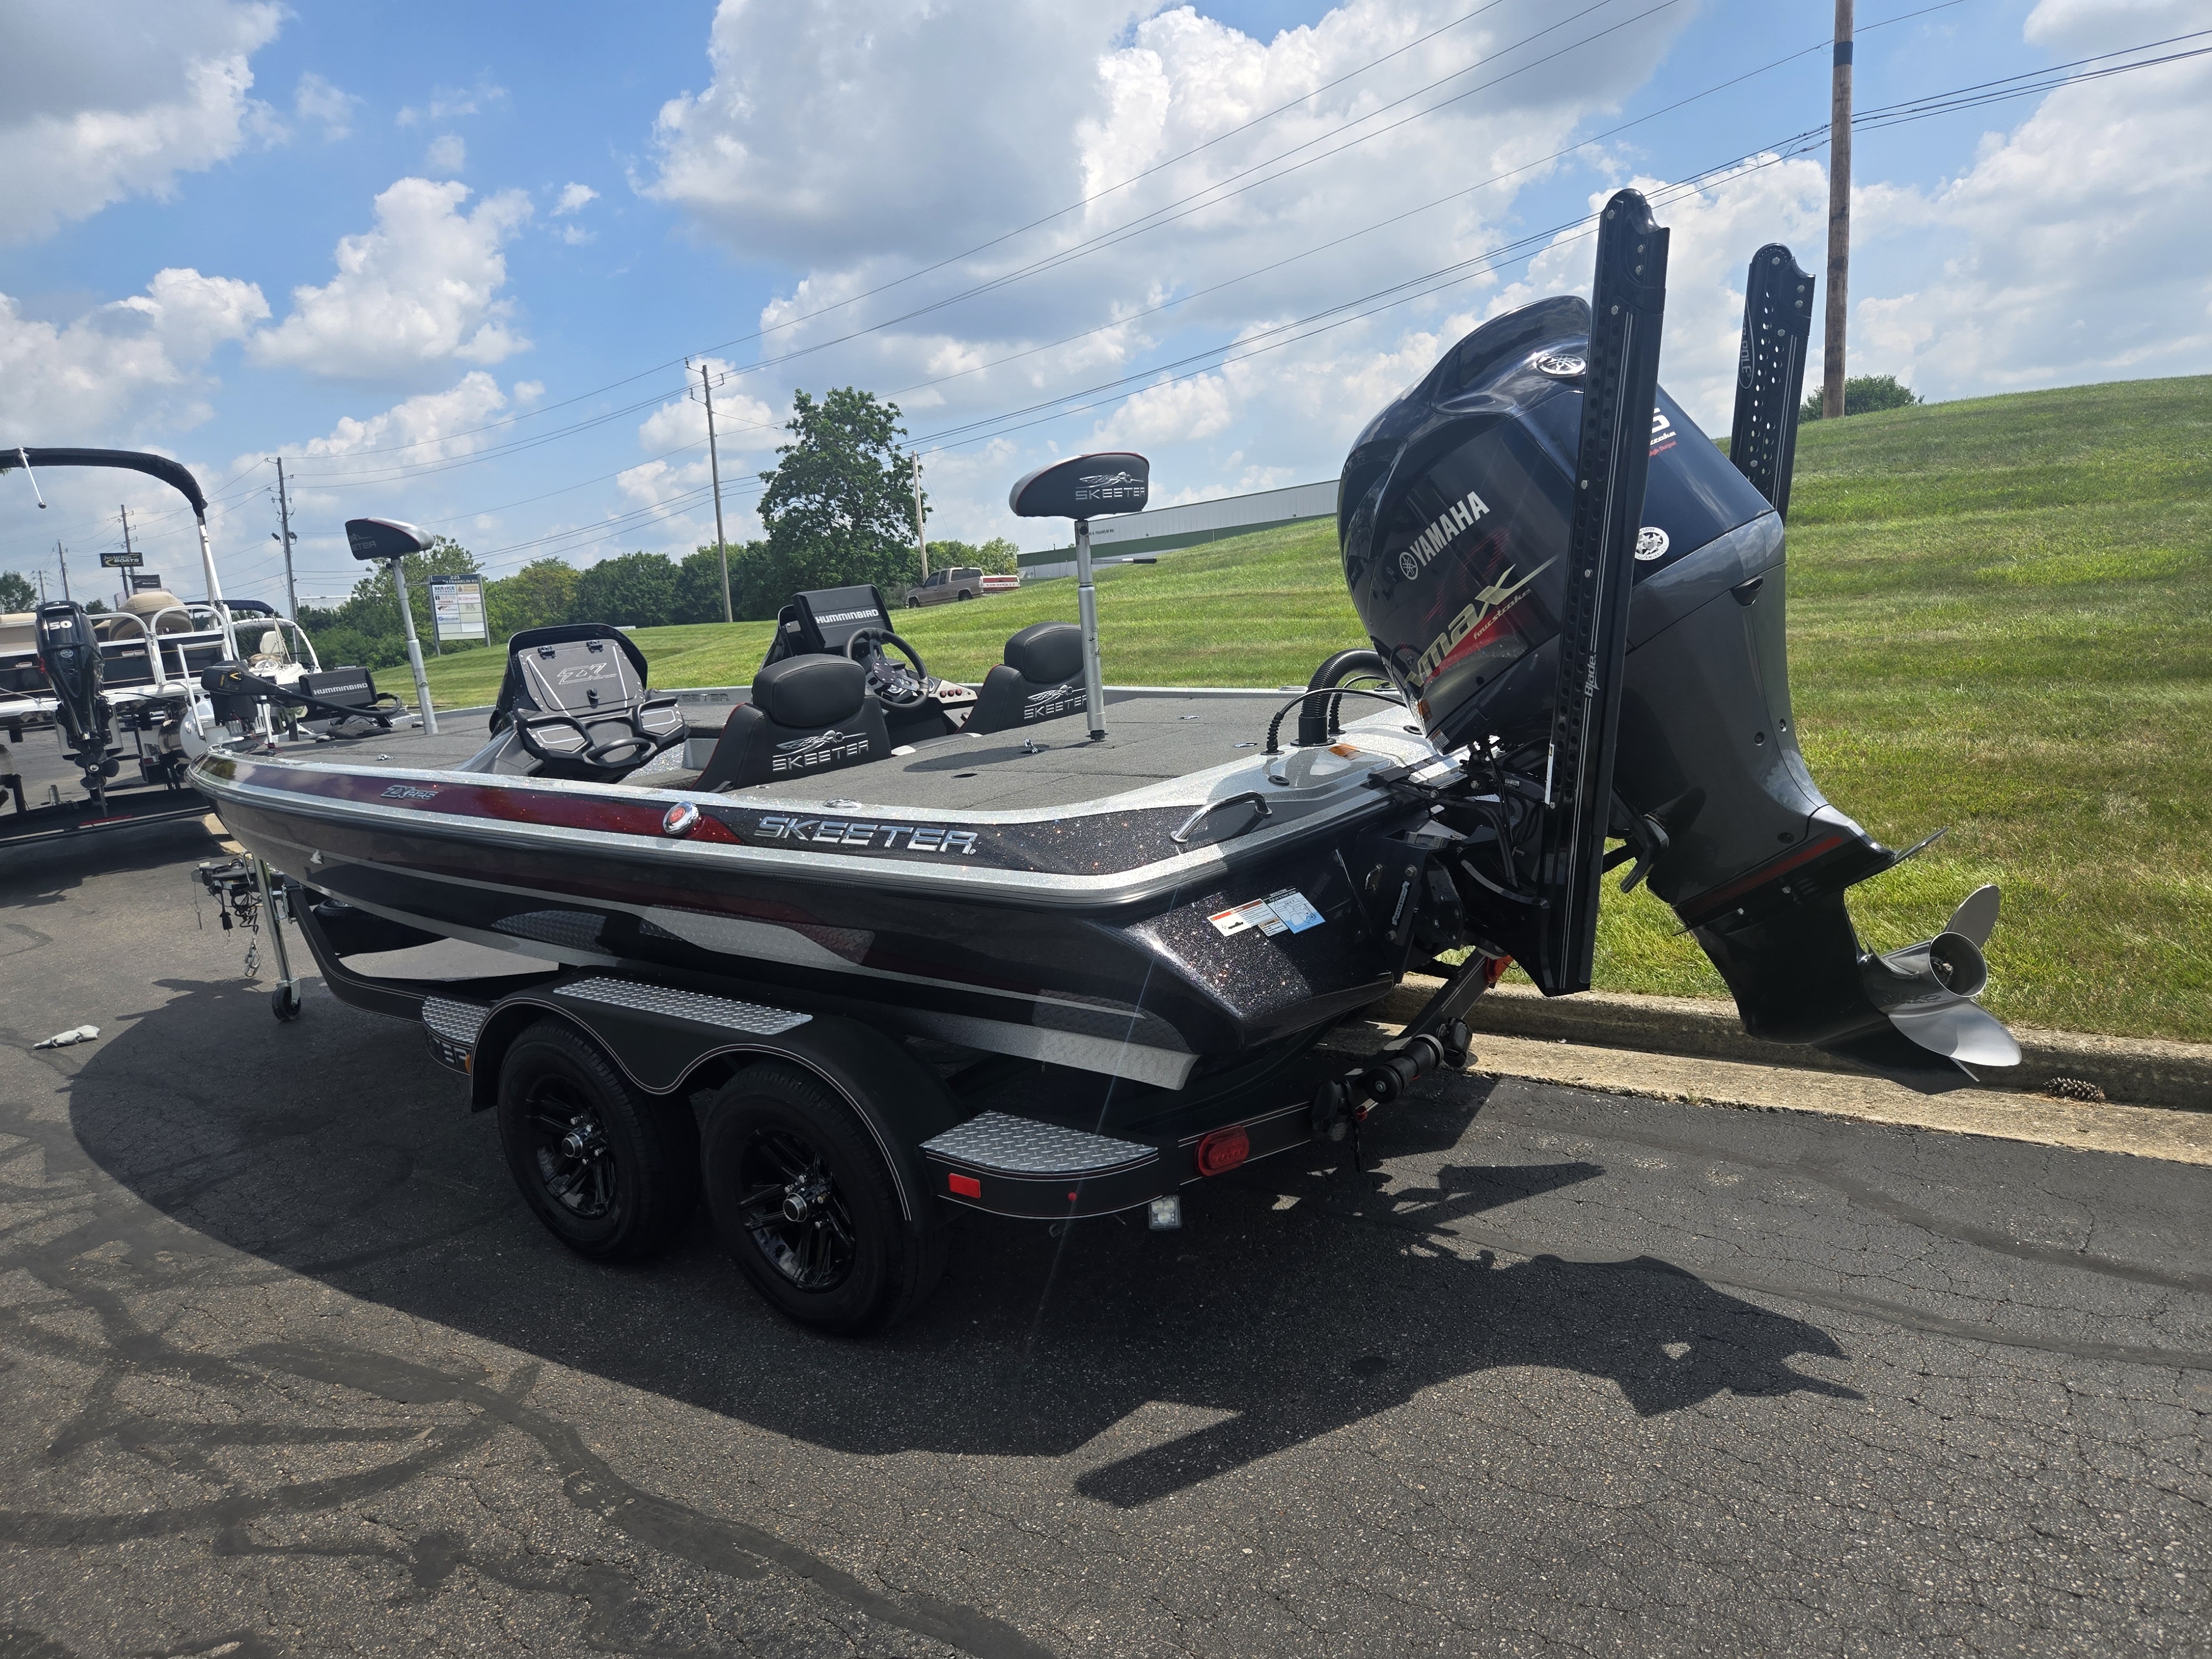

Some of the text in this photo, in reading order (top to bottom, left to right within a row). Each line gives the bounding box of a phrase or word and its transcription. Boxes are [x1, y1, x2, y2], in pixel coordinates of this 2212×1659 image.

[1076, 487, 1145, 500] SKEETER
[1410, 491, 1490, 567] YAMAHA
[49, 620, 72, 630] 50
[815, 609, 879, 624] HUMMINBIRD
[1473, 588, 1531, 640] fourstroke
[557, 663, 607, 685] ZX
[313, 682, 368, 695] HUMMINBIRD
[773, 739, 869, 772] SKEETER
[754, 816, 978, 855] SKEETER
